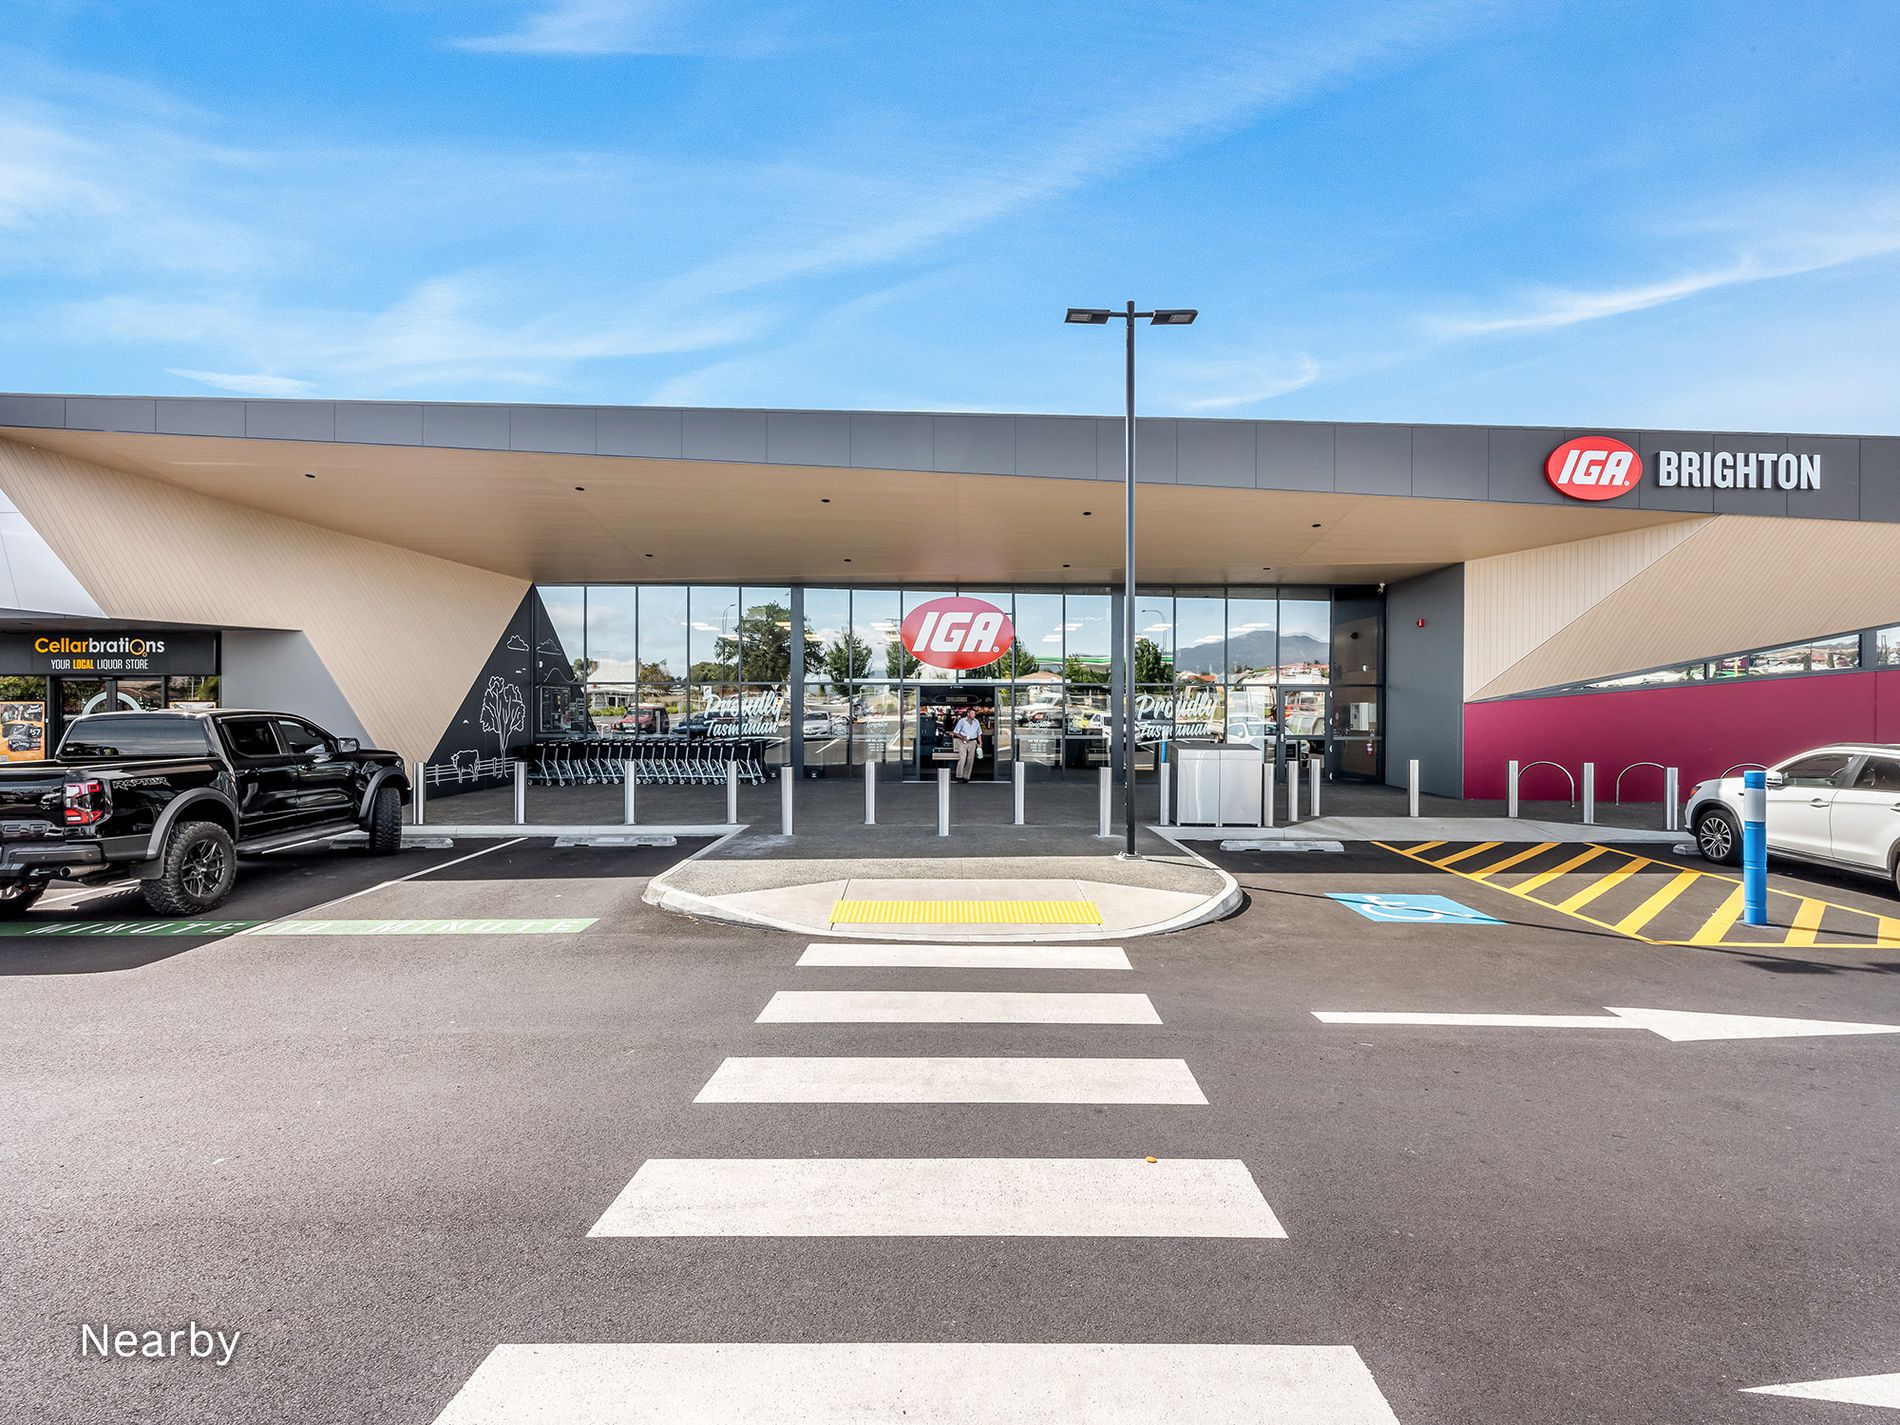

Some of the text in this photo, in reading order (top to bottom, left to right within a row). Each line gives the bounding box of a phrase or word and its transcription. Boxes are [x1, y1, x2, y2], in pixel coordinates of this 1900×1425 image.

[1557, 450, 1821, 490] IGA BRIGHTON
[912, 612, 1004, 653] IGA
[35, 637, 165, 657] Cellarbrations
[50, 659, 149, 670] YOUR LOCAL LIQUOR STORE
[703, 690, 784, 722] Proudly
[1135, 690, 1219, 722] Proudly
[703, 720, 779, 737] Tasmanian
[1136, 720, 1212, 738] Tasmanian
[112, 777, 171, 790] RAPTOR
[24, 923, 247, 934] MINUTE
[369, 921, 581, 933] MINUTE
